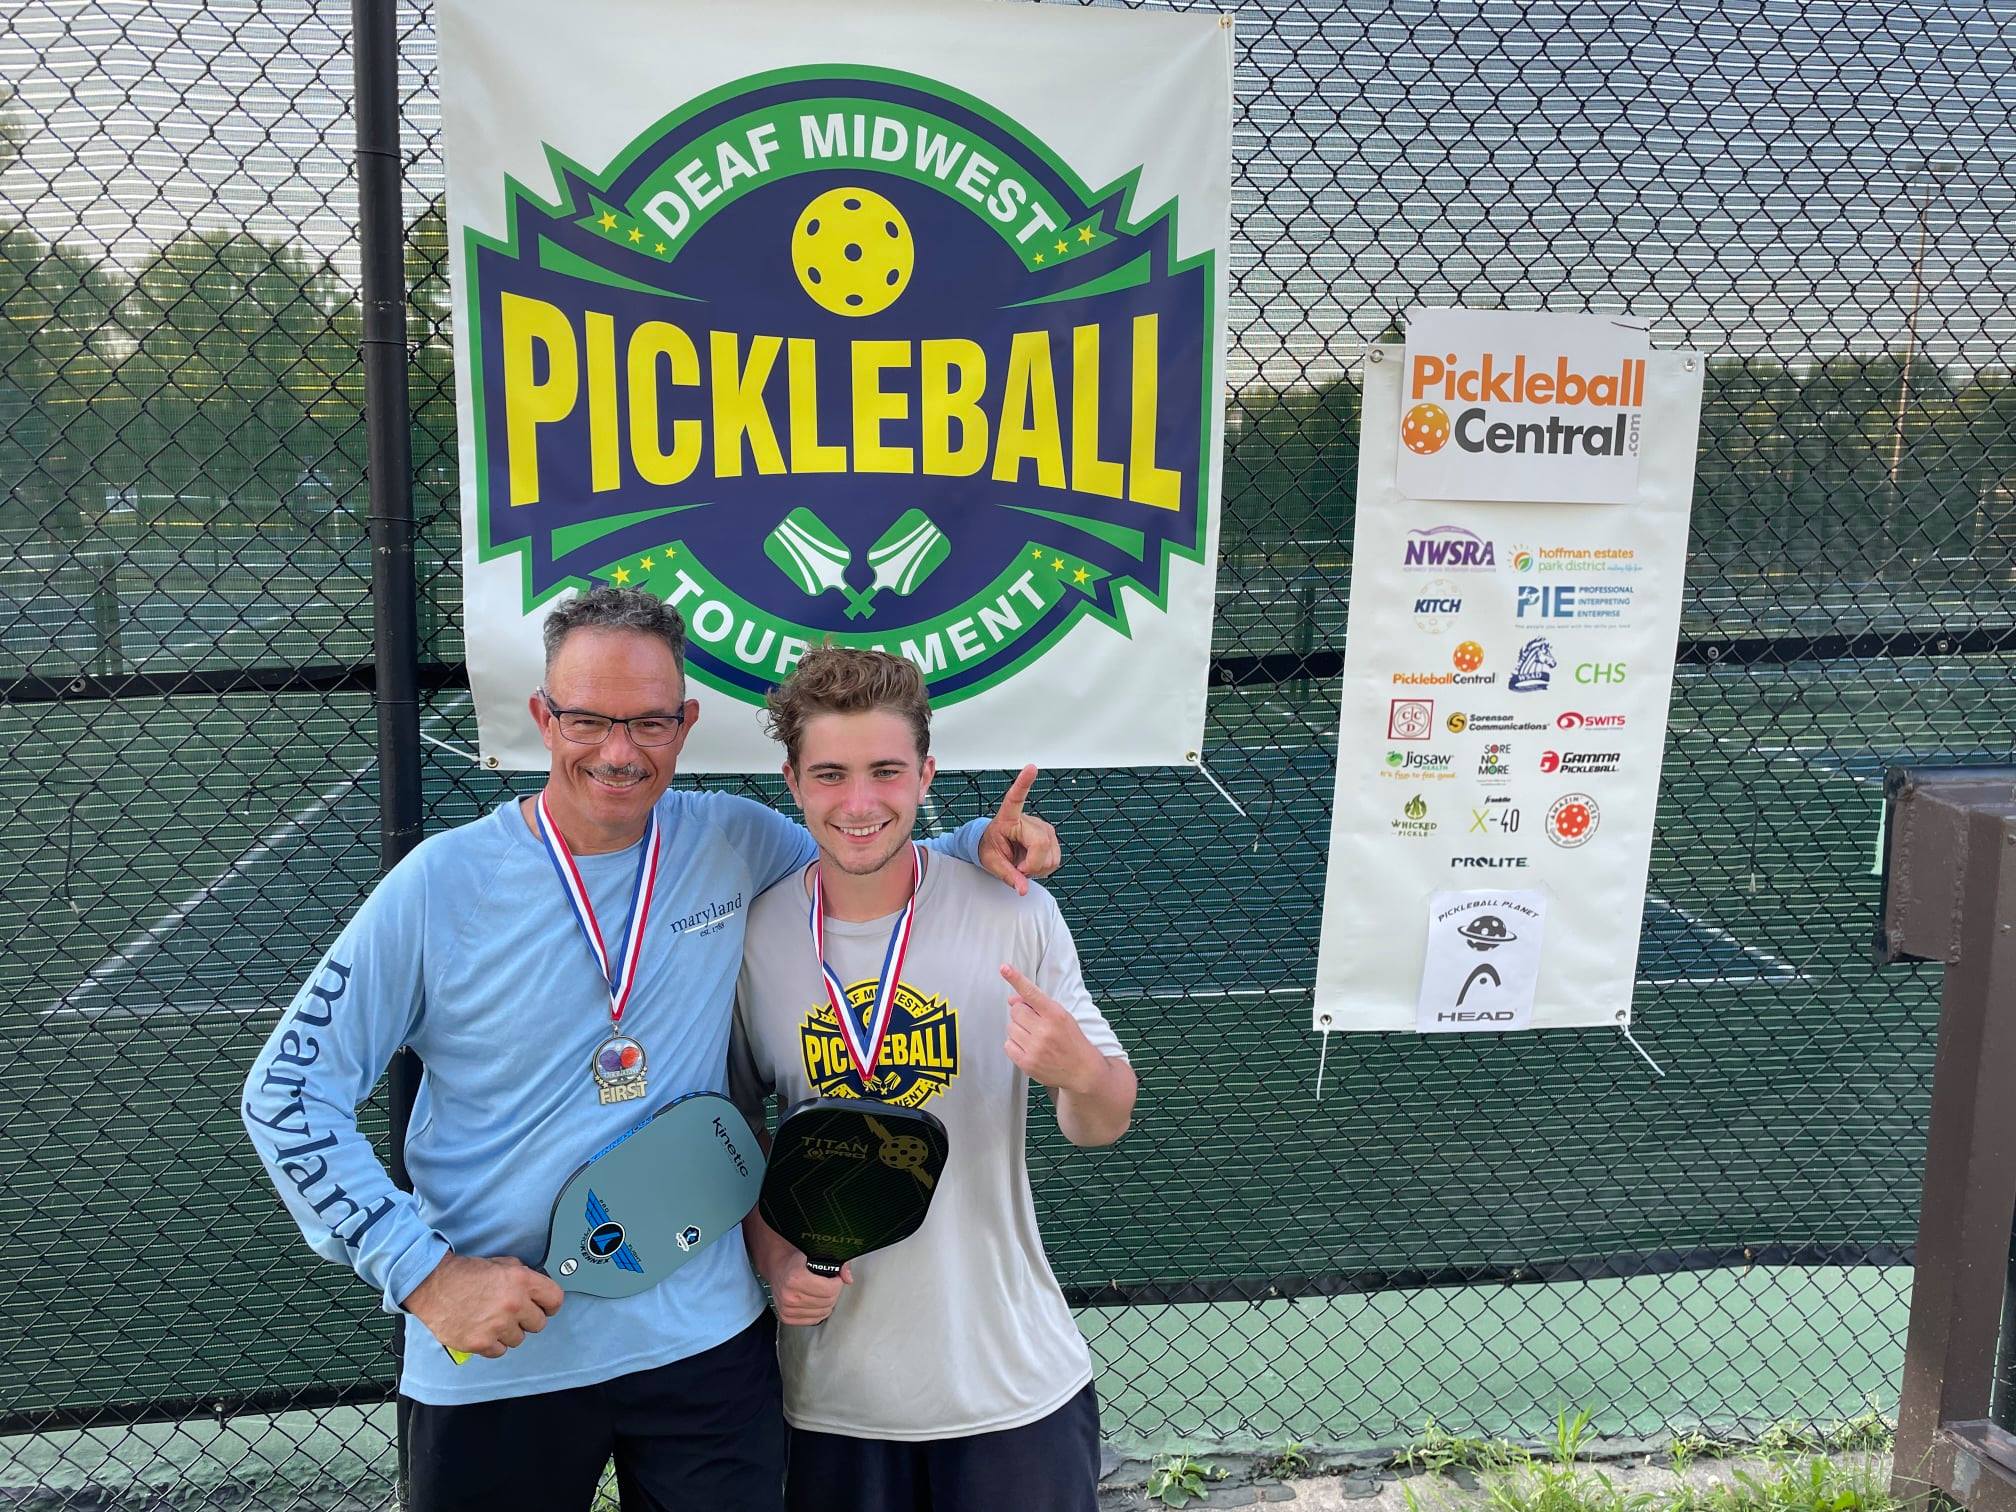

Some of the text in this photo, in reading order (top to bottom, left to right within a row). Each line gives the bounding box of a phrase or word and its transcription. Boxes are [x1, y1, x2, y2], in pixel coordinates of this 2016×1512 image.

[642, 113, 1057, 245] DEAF MIDWEST
[1411, 353, 1646, 407] Pickleball
[500, 291, 1182, 512] PICKLEBALL
[1454, 408, 1627, 456] Central
[1404, 540, 1496, 566] NWSRA
[1539, 547, 1634, 559] hoffman estates
[1538, 561, 1563, 573] park
[1564, 561, 1606, 571] district
[1414, 598, 1462, 614] KITCH
[1516, 586, 1575, 618] PIE
[663, 569, 1046, 675] TOURMENT
[1574, 662, 1627, 684] CHS
[1468, 723, 1548, 731] Communications
[1469, 714, 1514, 722] Sorenson
[1585, 715, 1626, 727] SWITS
[1484, 744, 1511, 754] SORE
[1402, 751, 1451, 768] Jigsaw
[1481, 755, 1498, 765] NO
[1478, 765, 1510, 775] MORE
[1451, 857, 1528, 868] PROLITE
[670, 892, 742, 934] maryland
[1437, 899, 1540, 923] PICKLEBALL PLANET
[1437, 1011, 1515, 1023] HEAD
[246, 952, 396, 1249] maryland
[600, 1081, 648, 1105] FIRST
[712, 1116, 749, 1178] Kinetic
[801, 1136, 869, 1154] TITAN
[801, 1232, 865, 1246] PROLITE
